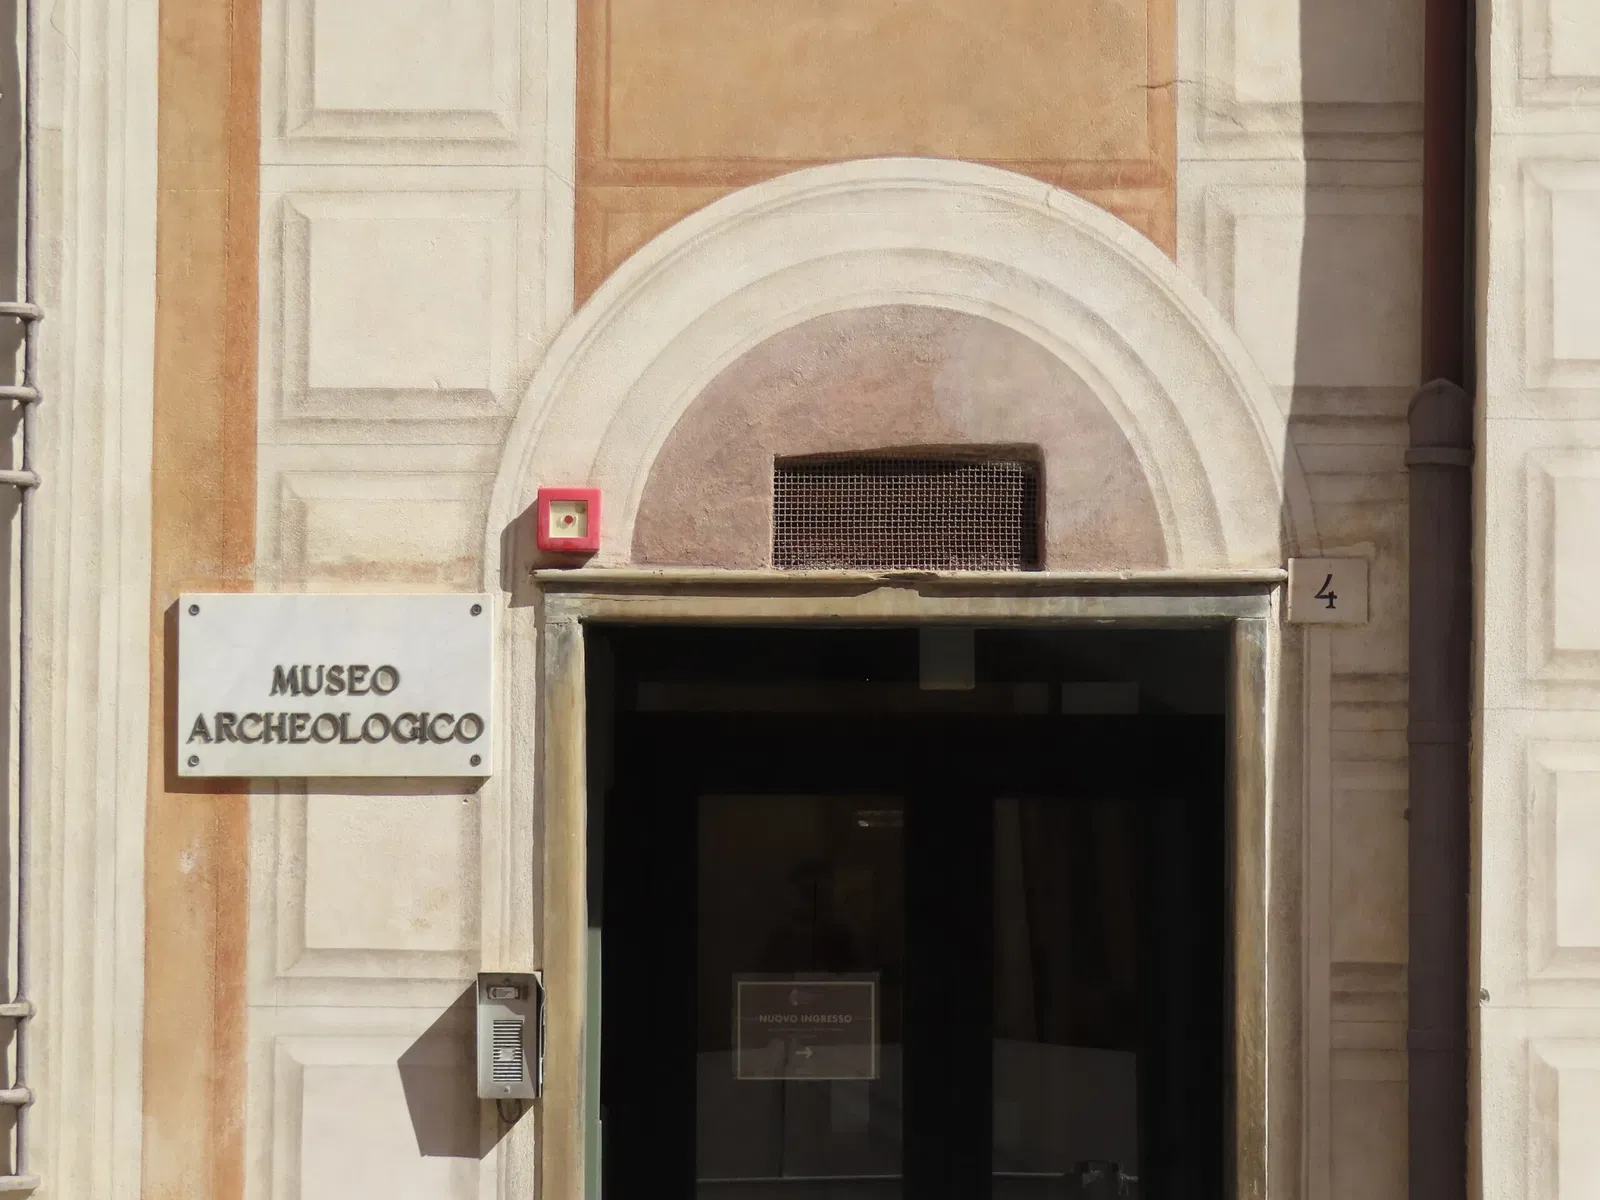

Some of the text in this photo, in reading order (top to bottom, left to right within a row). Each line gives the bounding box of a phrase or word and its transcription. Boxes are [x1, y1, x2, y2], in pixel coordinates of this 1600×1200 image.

[1314, 573, 1338, 609] 4
[269, 664, 400, 697] MUSEO
[186, 712, 485, 745] ARCHEOLOGICO
[759, 1014, 852, 1023] NUOVO INGRESSO
